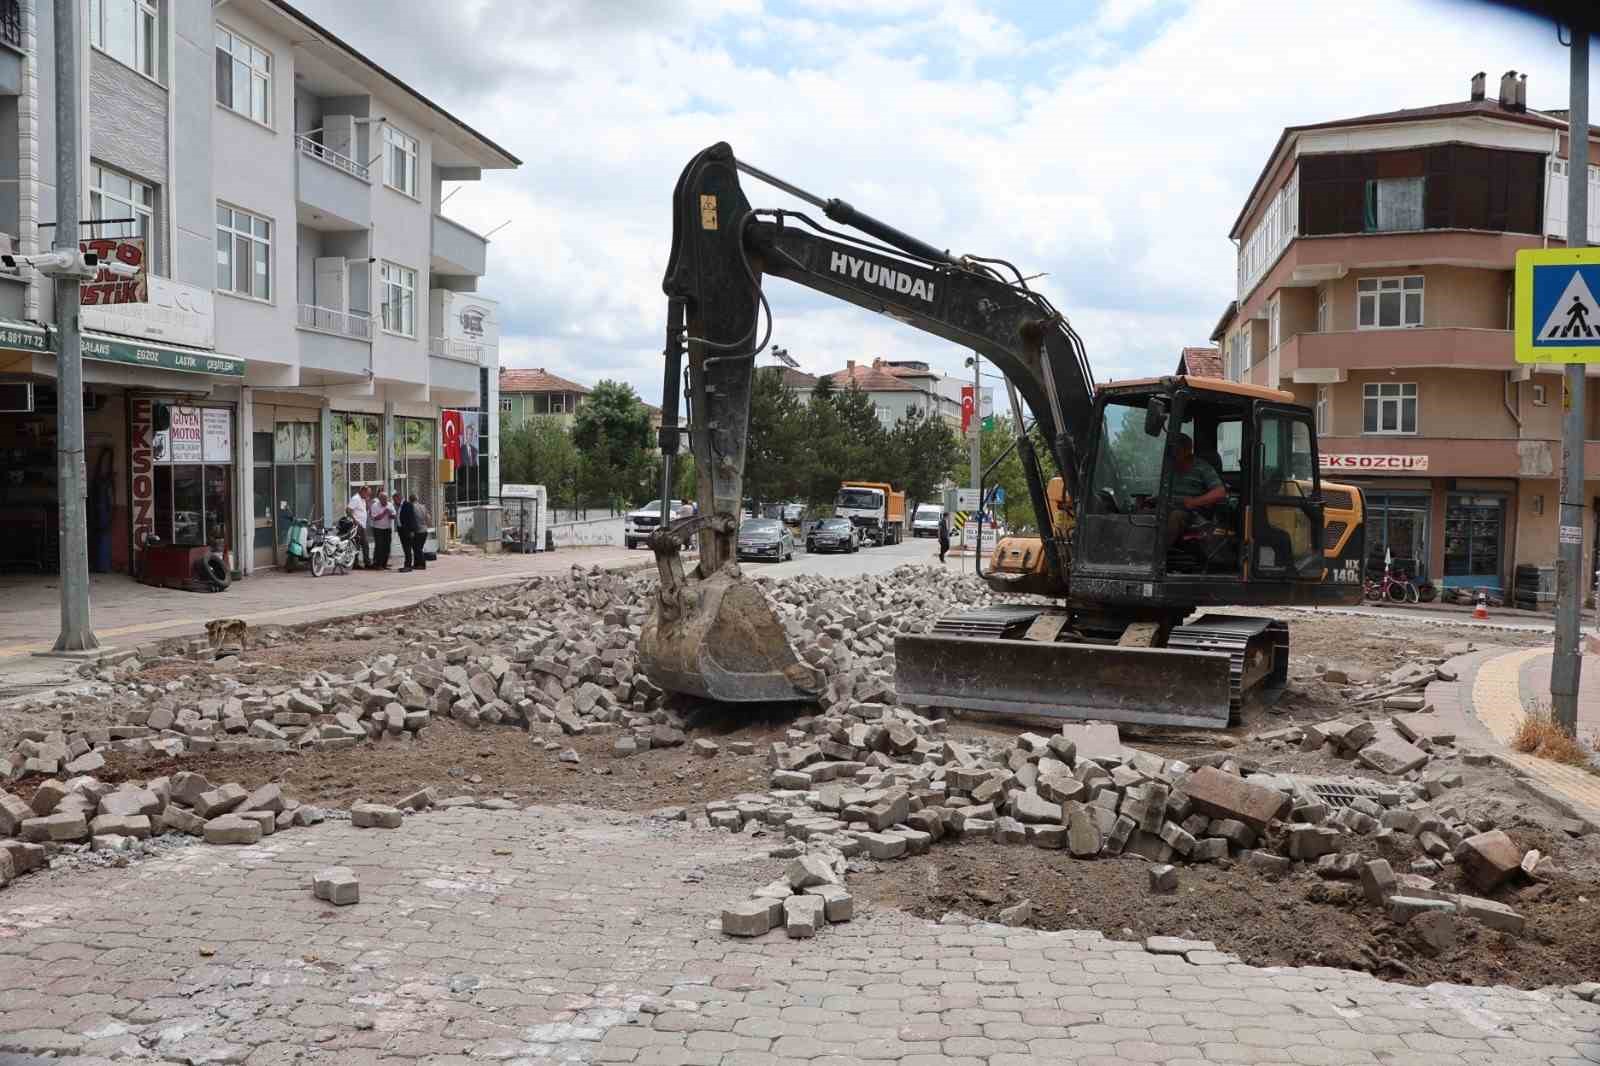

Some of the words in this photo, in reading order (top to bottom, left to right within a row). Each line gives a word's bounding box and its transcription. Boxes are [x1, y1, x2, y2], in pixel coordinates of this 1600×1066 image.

[830, 251, 935, 302] HYUNDAI
[172, 427, 200, 440] MOTOR
[1317, 456, 1413, 468] EKSOZCU
[1345, 559, 1360, 570] HX
